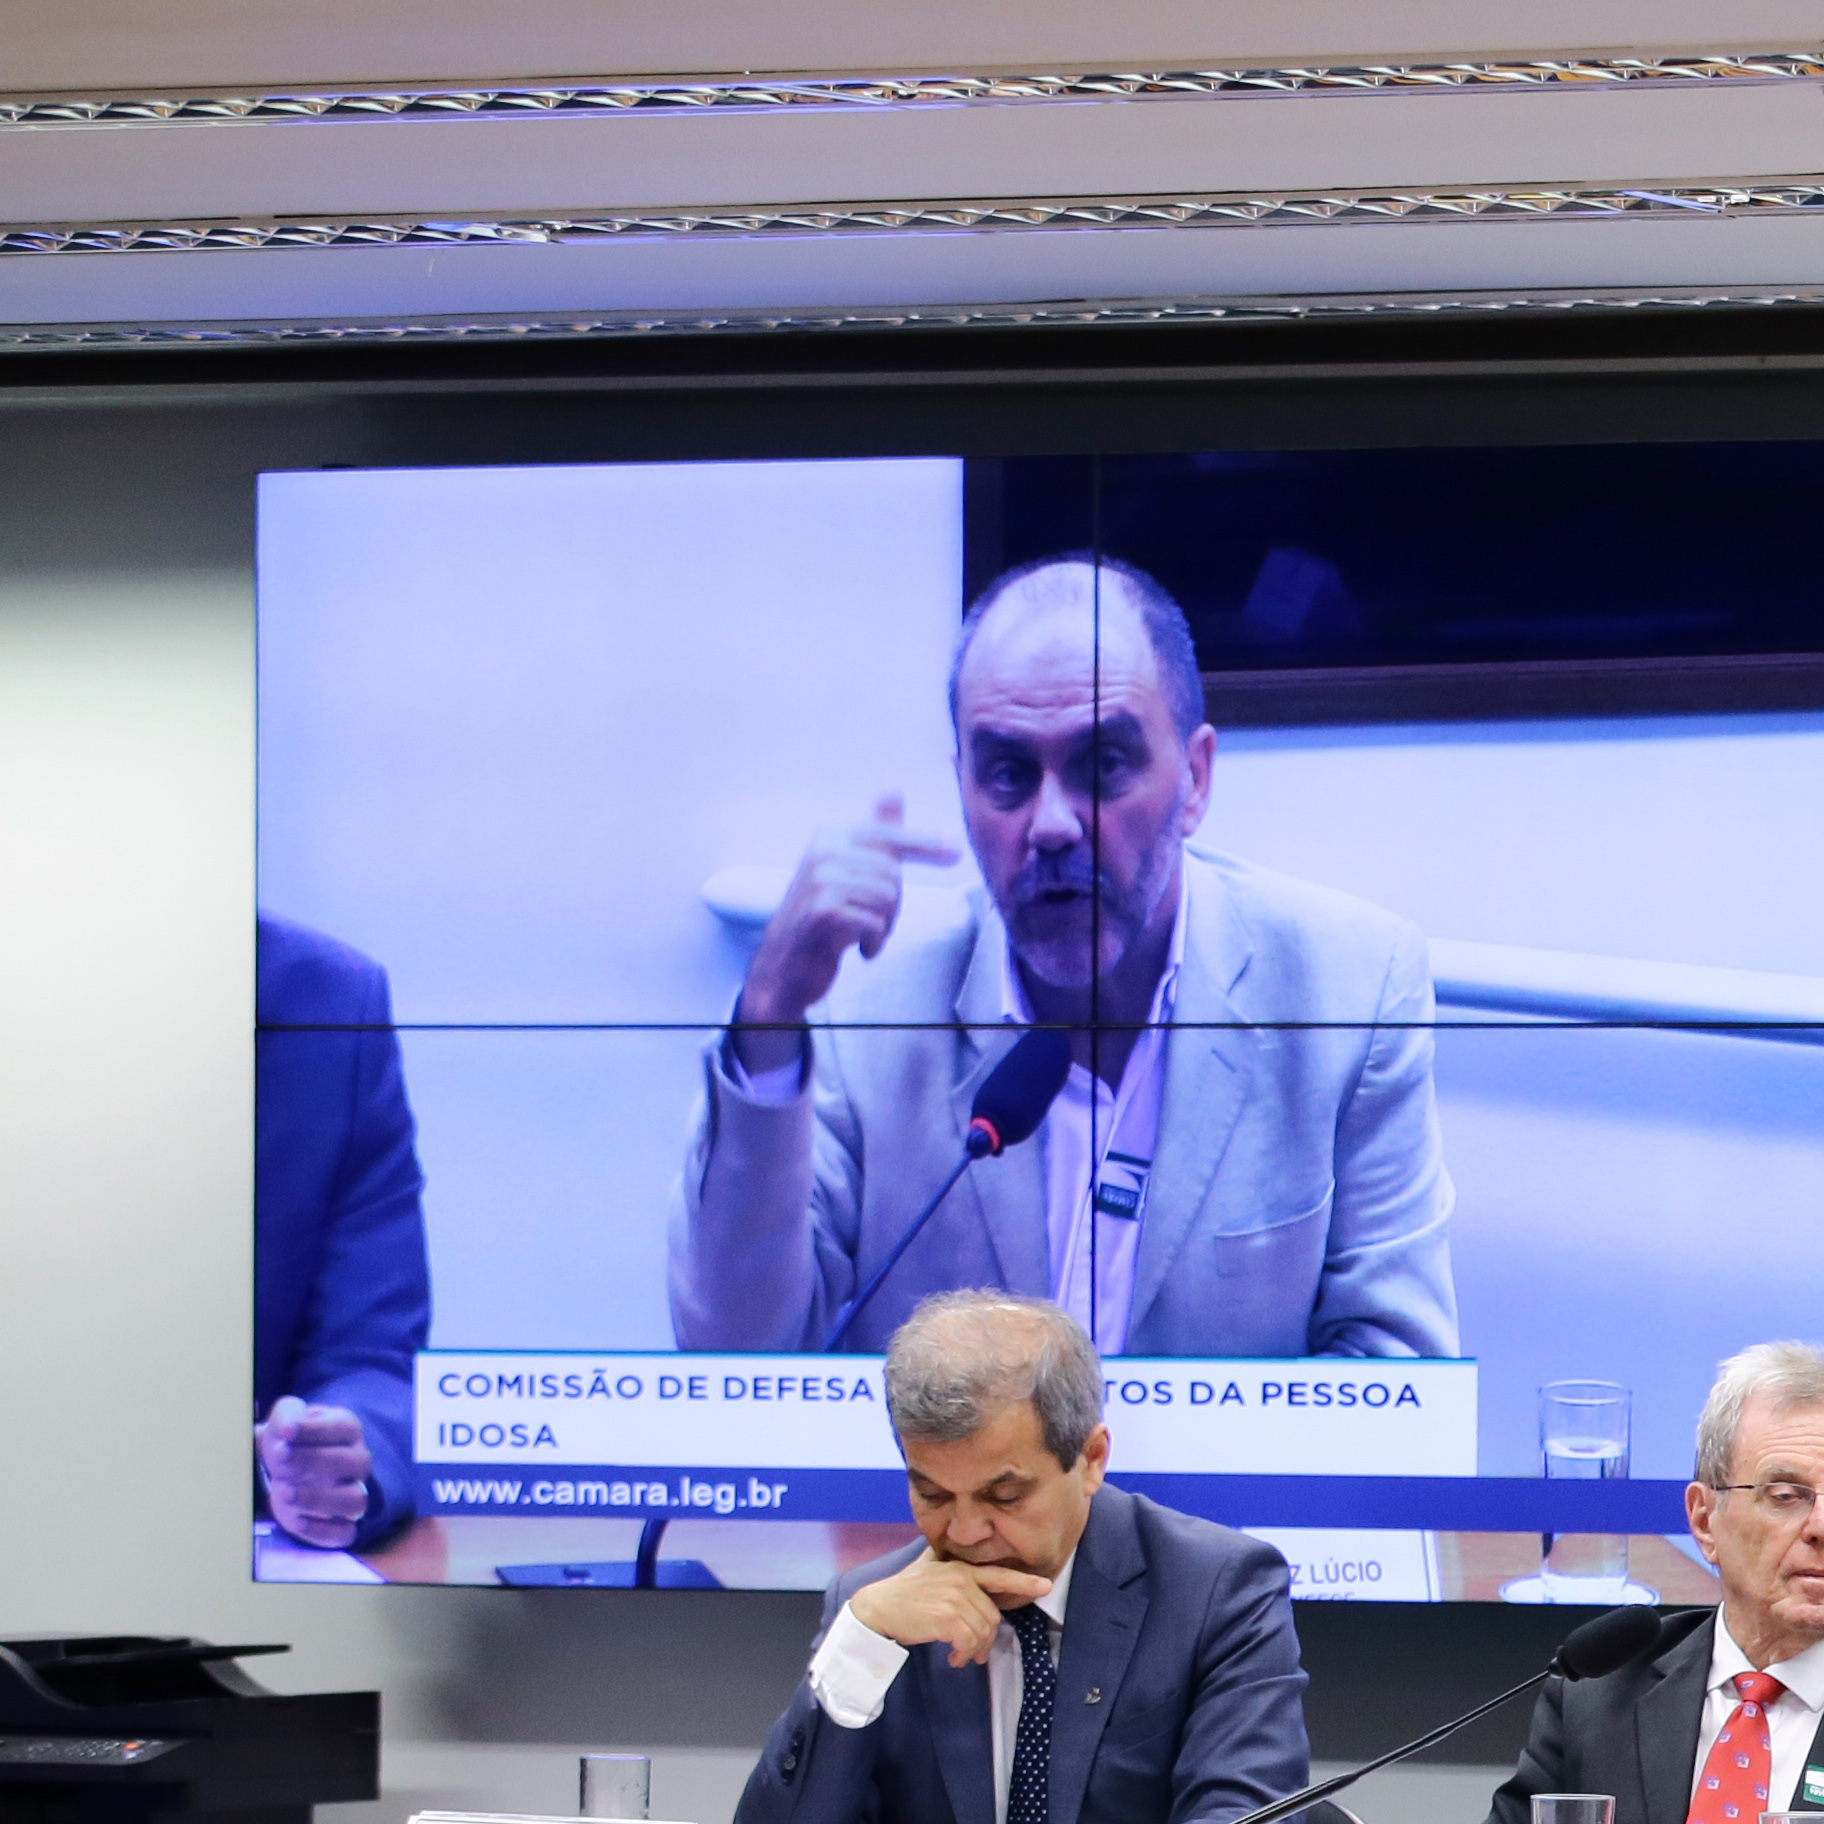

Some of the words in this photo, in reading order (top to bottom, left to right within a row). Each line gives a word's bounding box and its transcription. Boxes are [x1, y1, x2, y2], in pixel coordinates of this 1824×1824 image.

[438, 1368, 644, 1401] COMISSÃO
[658, 1374, 706, 1400] DE
[722, 1374, 876, 1402] DEFESA
[1103, 1379, 1174, 1405] TOS
[1190, 1381, 1246, 1406] DA
[1261, 1380, 1421, 1409] PESSOA
[438, 1421, 559, 1449] IDOSA
[432, 1478, 788, 1513] www.camara.leg.br
[1311, 1557, 1383, 1584] LÚCIO
